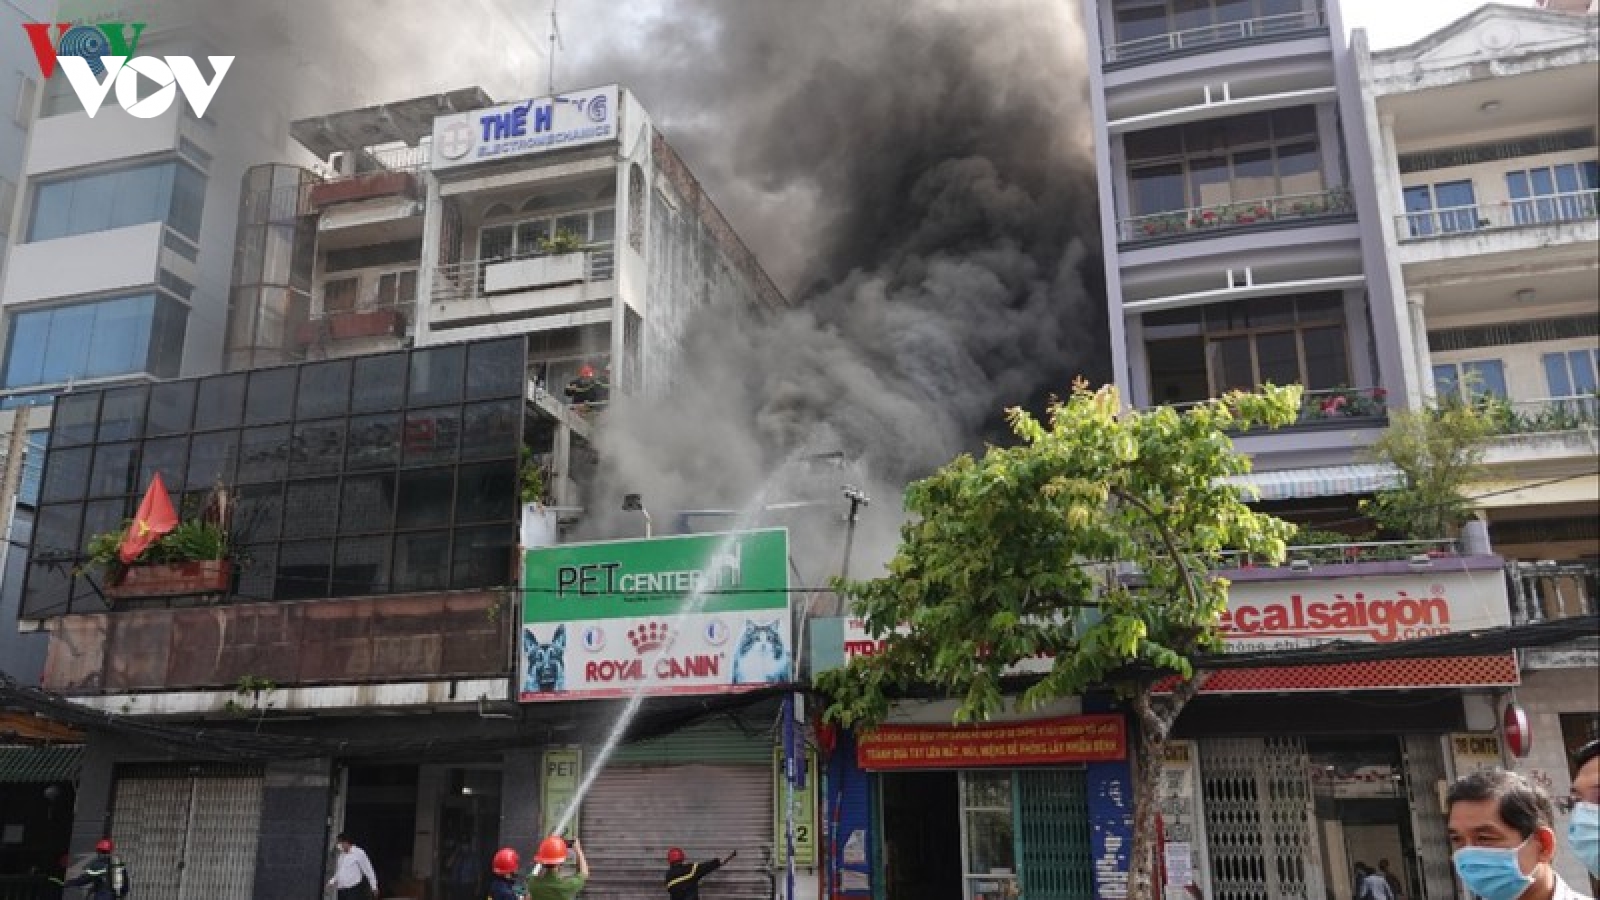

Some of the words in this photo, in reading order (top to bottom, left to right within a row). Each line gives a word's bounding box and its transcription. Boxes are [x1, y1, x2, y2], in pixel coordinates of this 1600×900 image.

[557, 562, 622, 598] PET
[619, 569, 703, 594] CENTER
[586, 659, 647, 682] ROYAL
[655, 653, 719, 679] CANIN
[548, 761, 575, 777] PET
